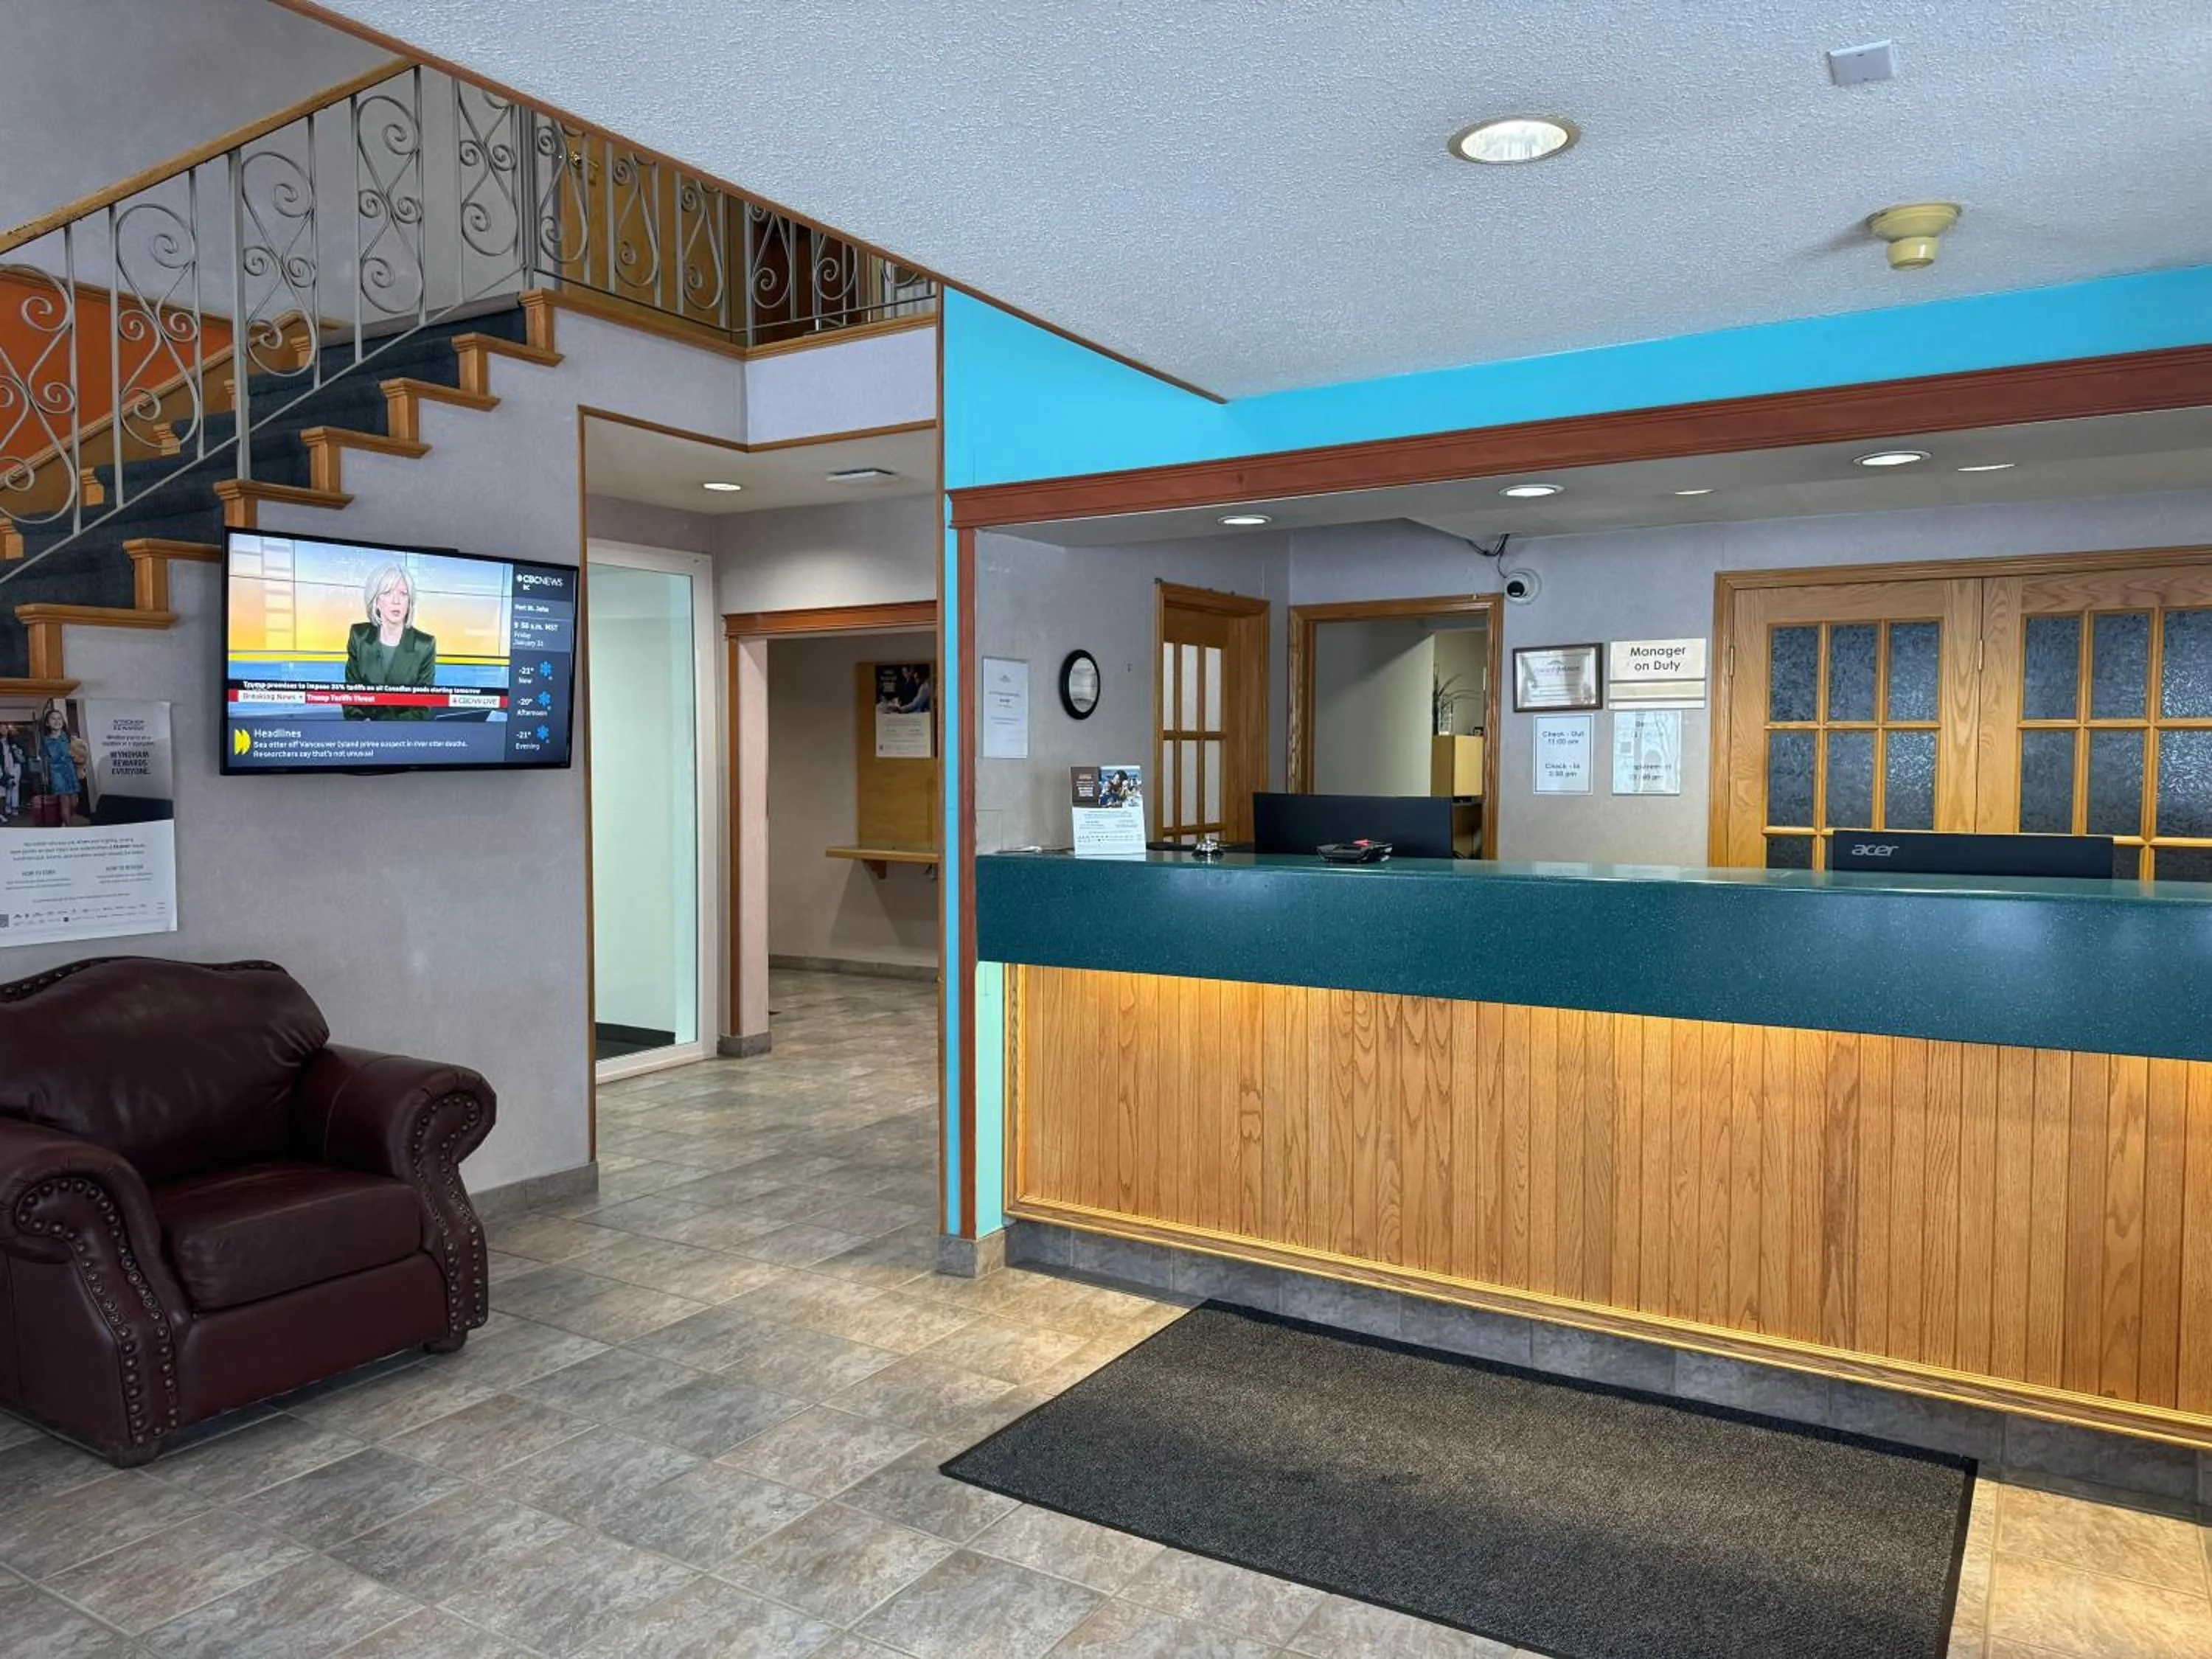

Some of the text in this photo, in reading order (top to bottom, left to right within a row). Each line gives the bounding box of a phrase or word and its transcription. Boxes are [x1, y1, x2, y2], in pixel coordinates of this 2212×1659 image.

[1630, 646, 1686, 658] Manager
[1634, 661, 1681, 672] on Duty
[243, 680, 266, 690] Trump
[267, 682, 297, 692] promises
[306, 683, 330, 691] impose
[430, 686, 453, 695] starting
[243, 692, 275, 701] Breaking
[307, 694, 330, 703] Trump
[353, 695, 375, 703] Threat
[517, 709, 548, 717] Afternoon
[254, 728, 302, 738] Headlines
[288, 740, 299, 748] off
[337, 740, 359, 748] Island
[380, 741, 407, 749] suspect
[515, 742, 540, 751] Evening
[253, 751, 298, 759] Researchers
[299, 751, 312, 759] say
[1851, 844, 1899, 858] acer
